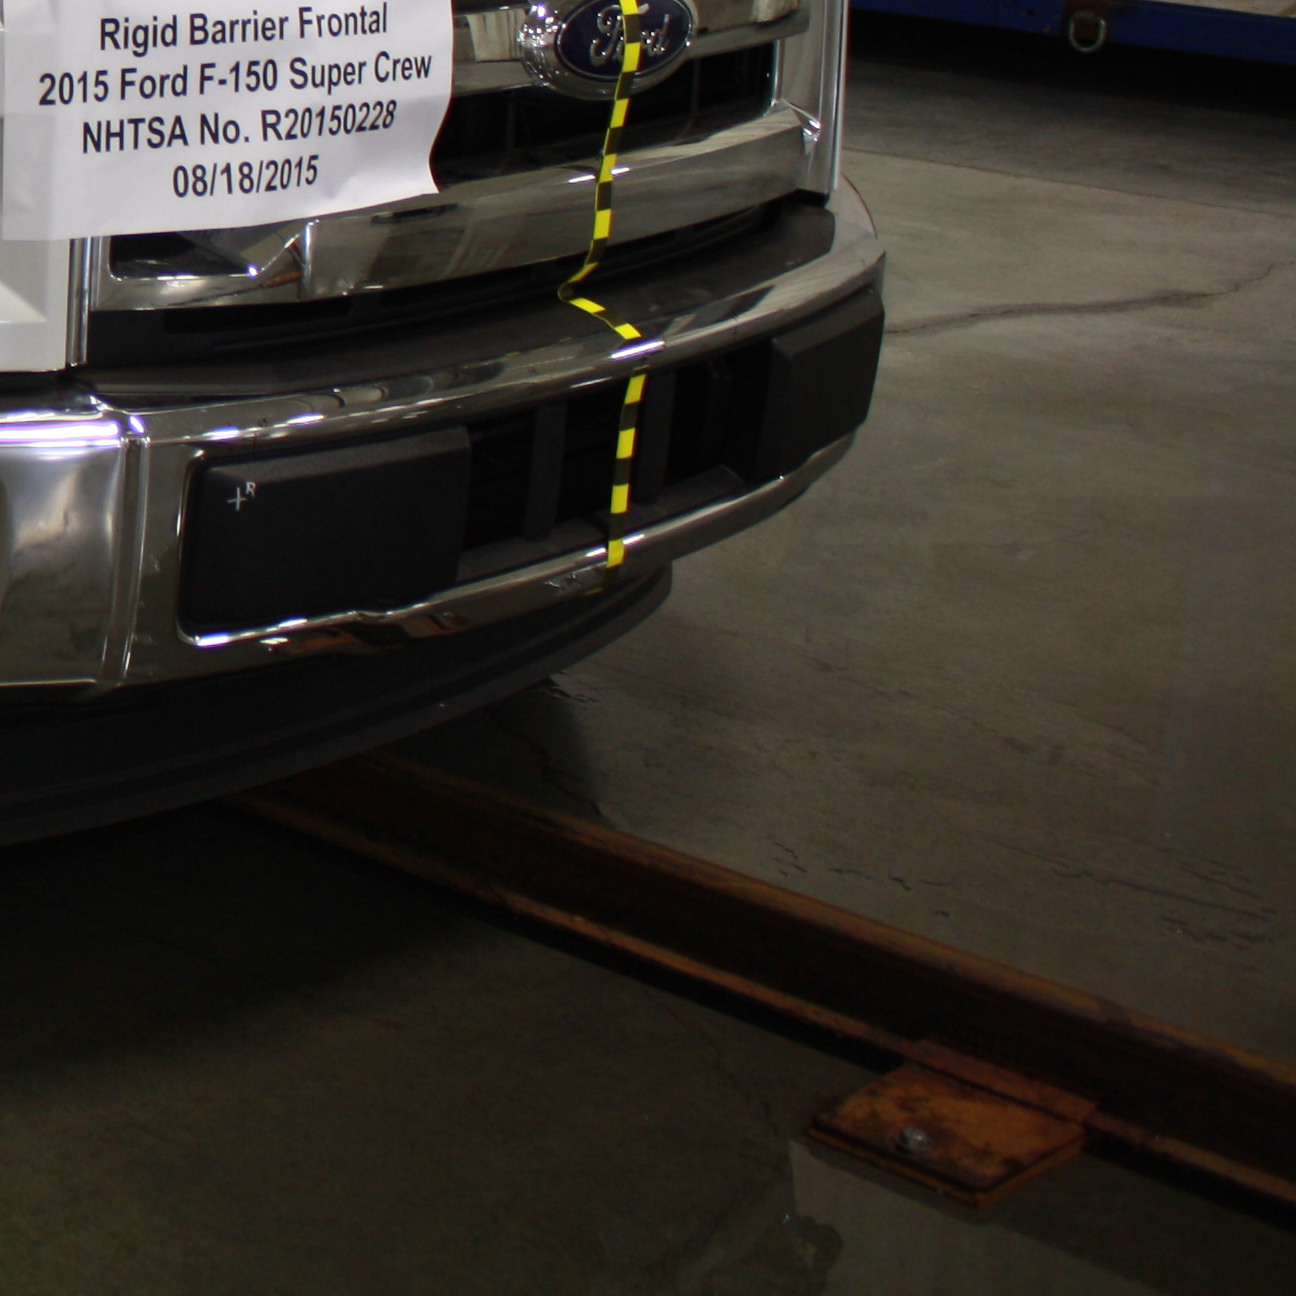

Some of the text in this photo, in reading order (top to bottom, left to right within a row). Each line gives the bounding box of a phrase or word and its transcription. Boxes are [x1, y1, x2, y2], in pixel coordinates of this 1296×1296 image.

[100, 2, 388, 57] Rigid Barrier Frontal
[589, 3, 670, 66] Fd
[38, 50, 433, 107] 2015 Ford F-150 Super Crew
[83, 100, 398, 155] NHTSA No. R20150228
[172, 155, 320, 198] 08/18/2015
